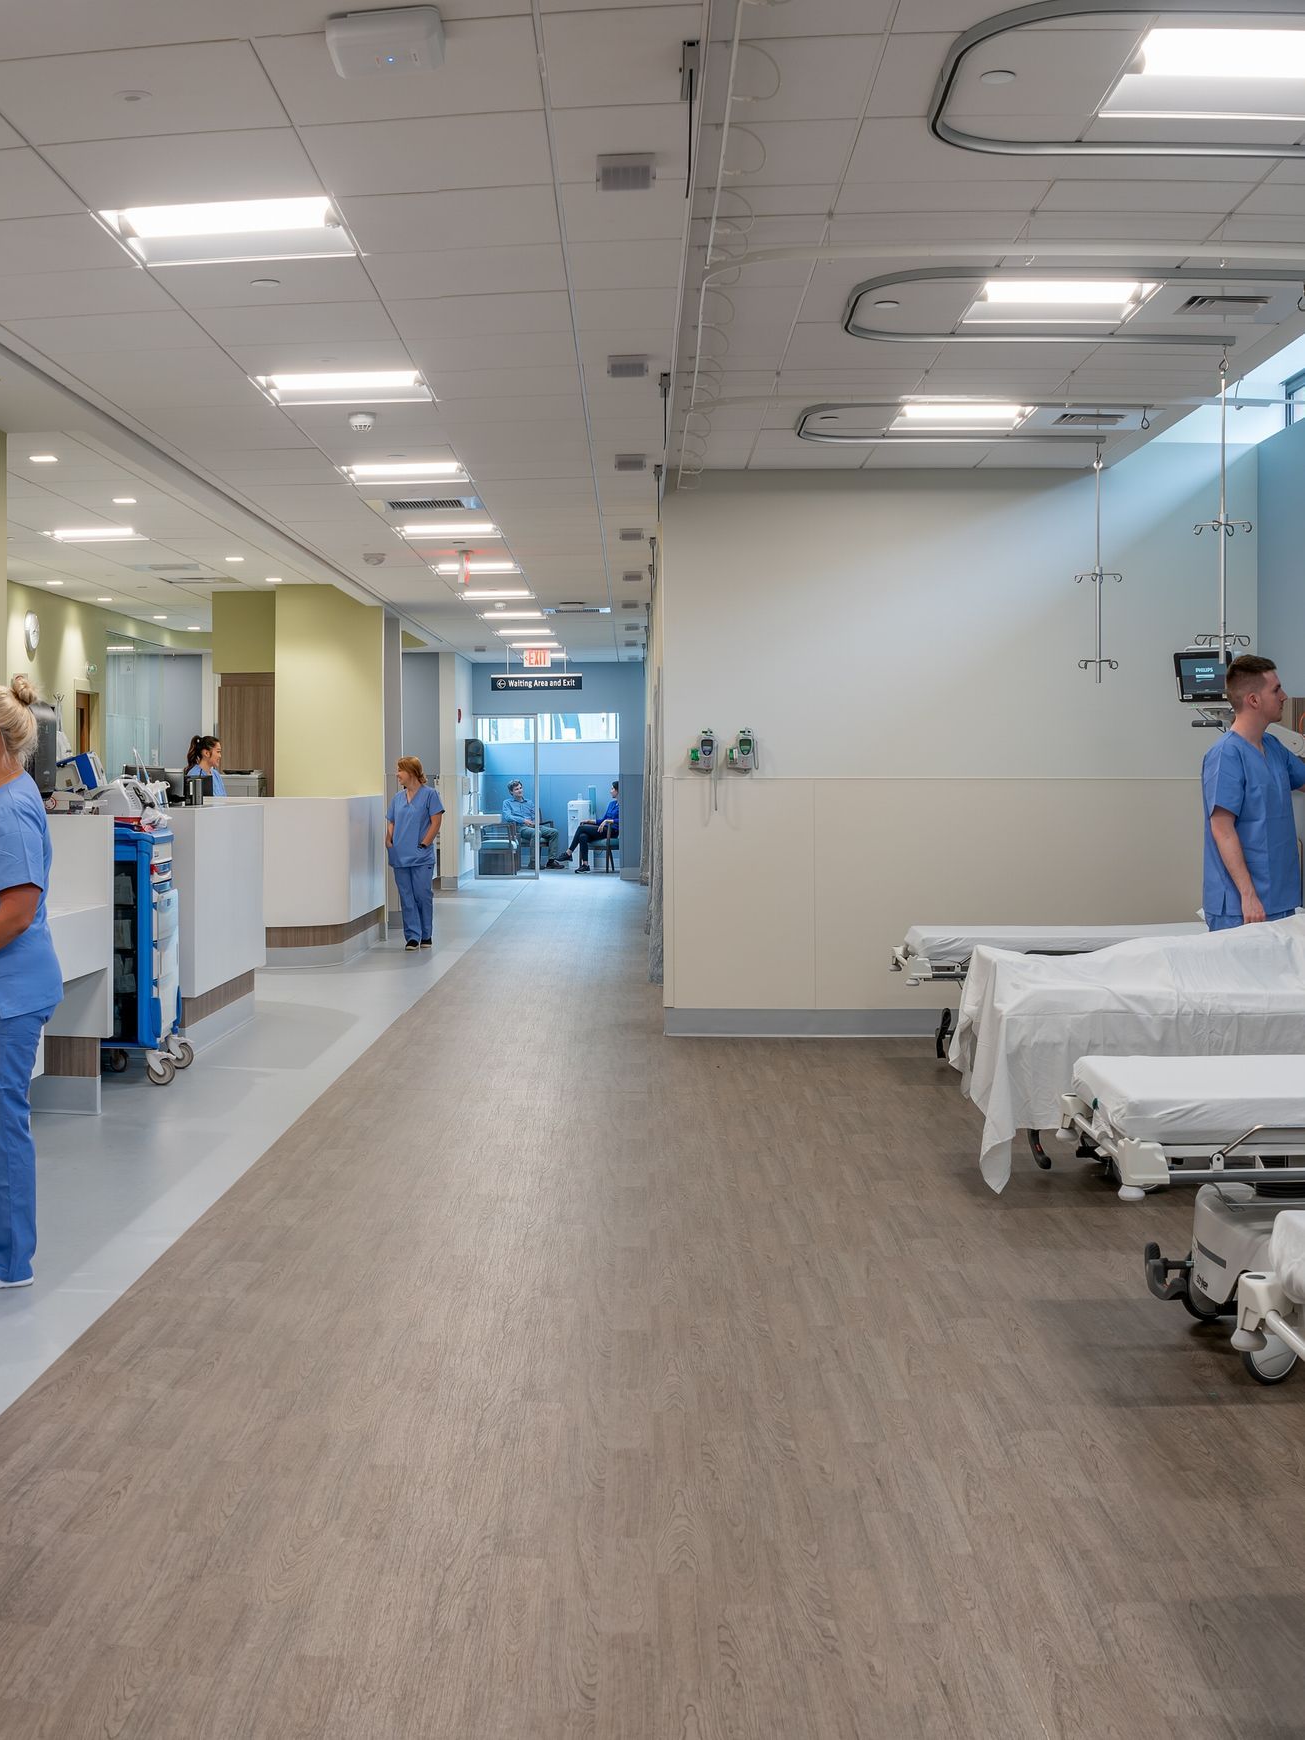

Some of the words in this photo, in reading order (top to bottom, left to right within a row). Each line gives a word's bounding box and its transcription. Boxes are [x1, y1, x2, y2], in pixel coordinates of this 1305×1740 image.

[528, 651, 546, 665] EXIT
[508, 680, 533, 688] Waiting
[550, 679, 561, 687] and
[562, 679, 576, 687] Exit
